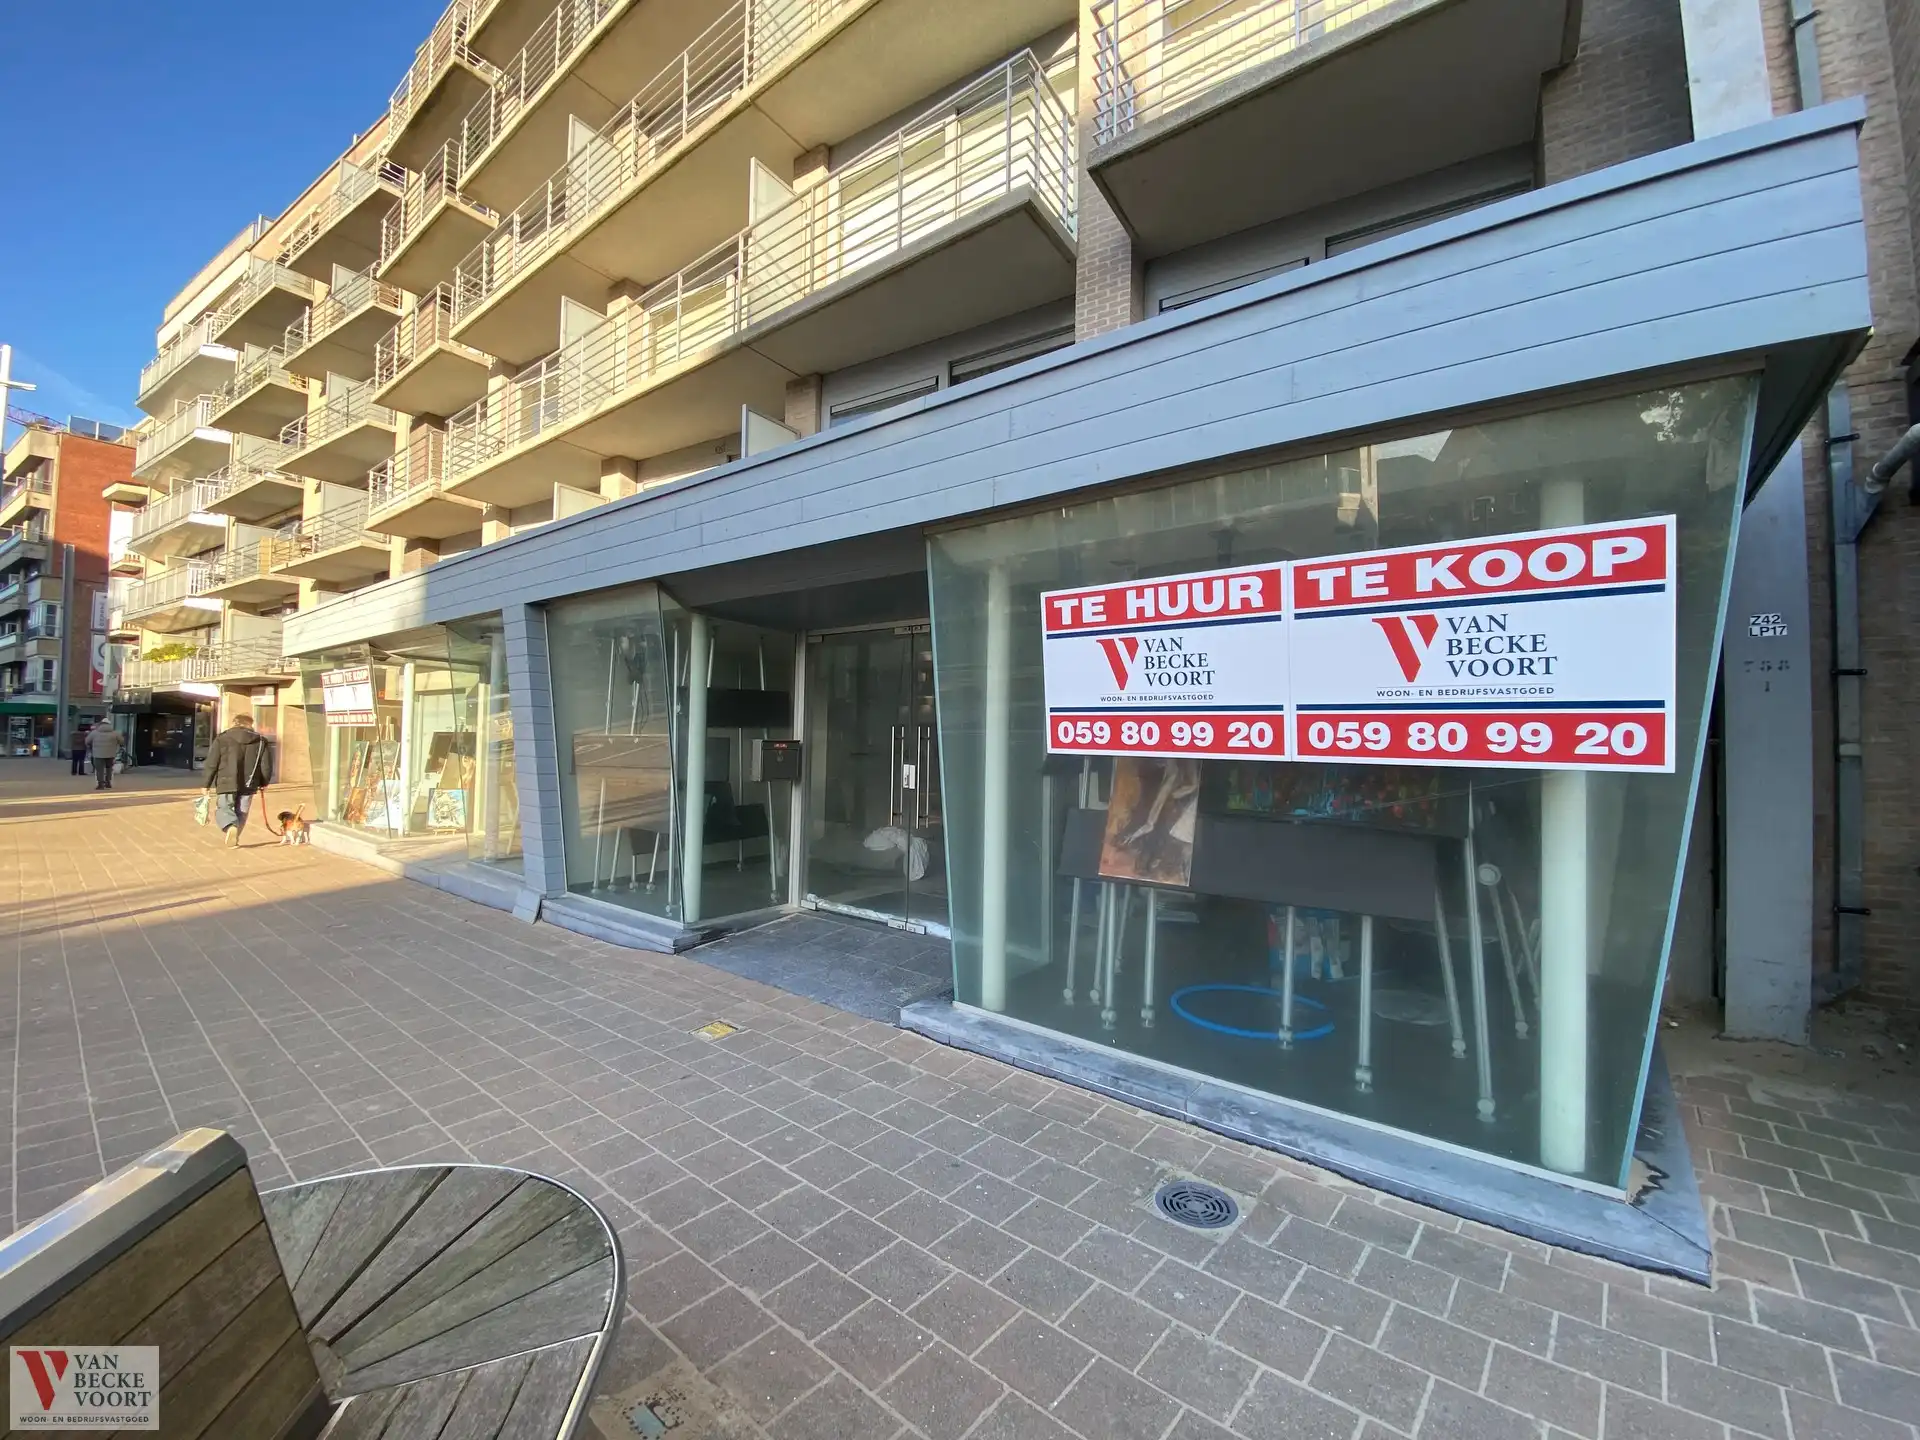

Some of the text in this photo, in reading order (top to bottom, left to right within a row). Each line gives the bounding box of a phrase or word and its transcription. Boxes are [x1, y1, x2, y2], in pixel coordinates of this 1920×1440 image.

[1307, 536, 1648, 601] TE KOOP
[1053, 575, 1265, 625] TE HUUR
[1446, 613, 1509, 634] VAN
[1751, 614, 1781, 625] Z42
[1750, 626, 1787, 637] LP17
[1143, 637, 1184, 653] VAN
[1446, 633, 1548, 657] BECKE
[1144, 652, 1209, 671] BECKE
[1446, 656, 1559, 678] VOORT
[1144, 669, 1216, 687] VOORT
[1139, 693, 1214, 702] BEDRIJFSVASTGOED
[1376, 686, 1555, 698] WOON- EN BEDRIJFSVASTGOED
[1057, 721, 1274, 748] 059 80 99 20
[1308, 721, 1648, 756] 059 80 99 20
